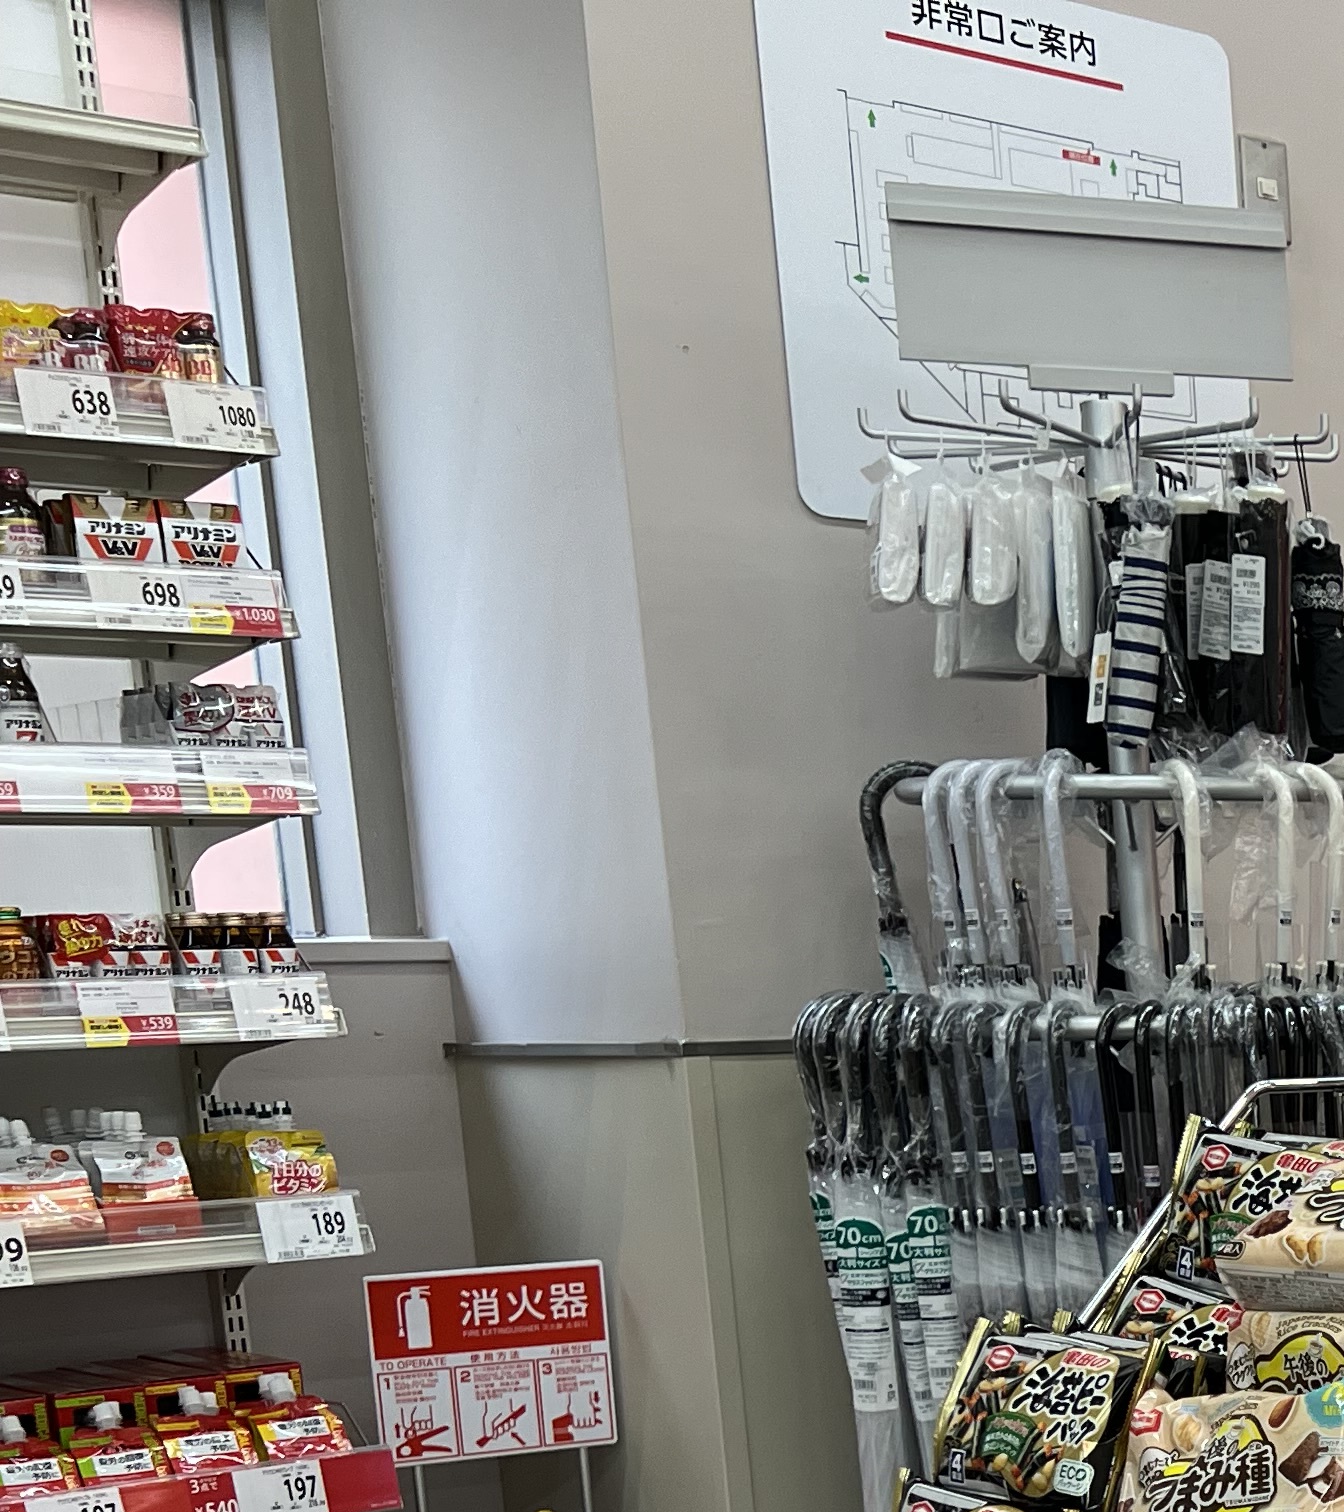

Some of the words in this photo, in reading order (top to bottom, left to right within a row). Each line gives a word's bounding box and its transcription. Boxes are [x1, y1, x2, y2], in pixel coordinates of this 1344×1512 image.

[911, 0, 1097, 67] 非常口ご案内
[72, 389, 110, 416] 638
[218, 405, 256, 428] 1080
[88, 520, 146, 536] アリナミン
[172, 525, 237, 542] アリナミン
[142, 582, 180, 607] 698
[311, 1211, 346, 1236] 189
[460, 1282, 589, 1327] 消火器
[397, 1357, 447, 1369] OPERATE
[283, 1475, 317, 1501] 197
